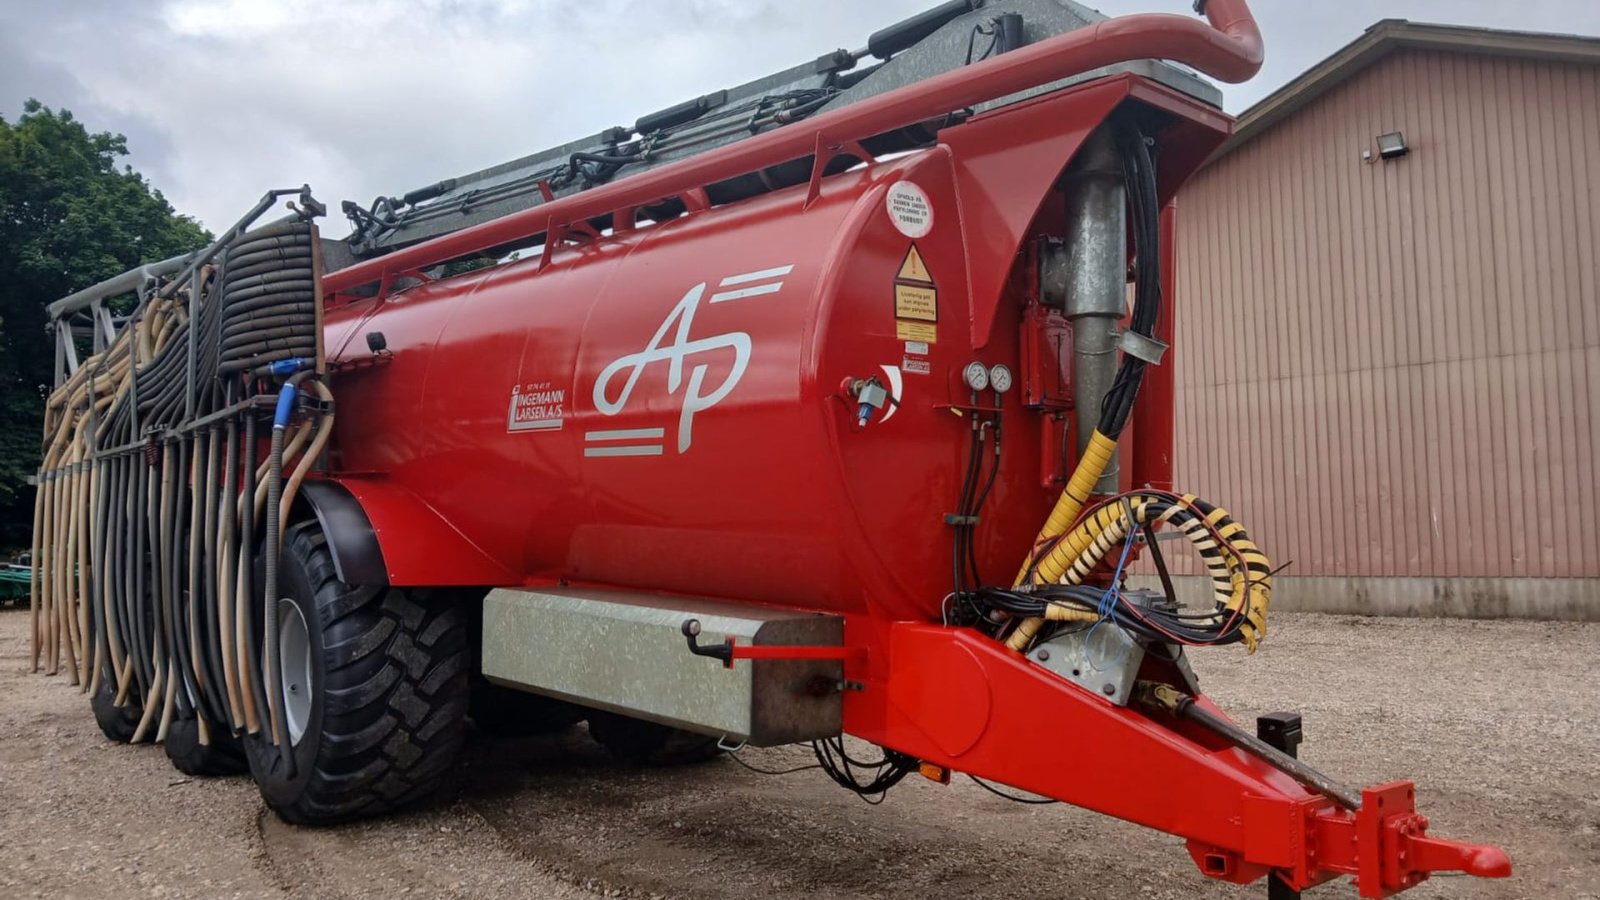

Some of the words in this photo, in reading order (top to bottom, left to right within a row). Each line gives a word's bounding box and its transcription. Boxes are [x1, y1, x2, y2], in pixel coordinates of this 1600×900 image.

[517, 389, 565, 406] INGEMANN
[515, 405, 547, 421] LARSEN
[547, 404, 563, 419] A/S
